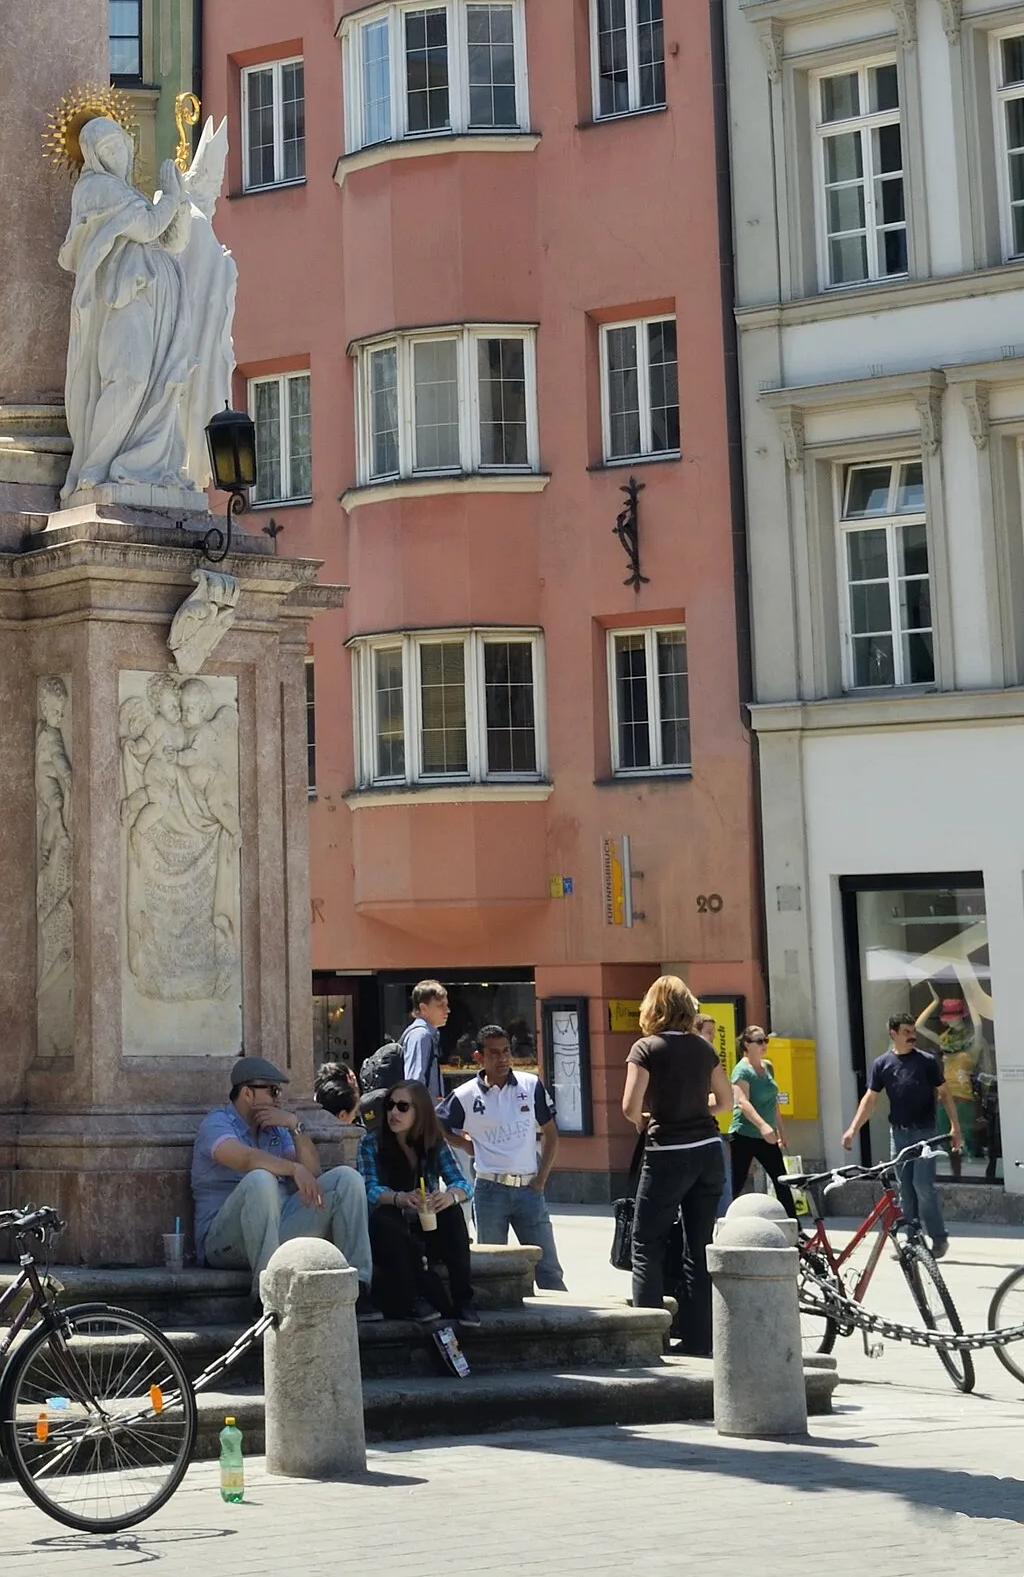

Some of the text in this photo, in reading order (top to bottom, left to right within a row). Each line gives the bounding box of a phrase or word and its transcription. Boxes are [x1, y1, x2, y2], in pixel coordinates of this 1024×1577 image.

[696, 893, 723, 913] 20
[473, 1095, 486, 1115] 4
[484, 1119, 530, 1142] WALES
